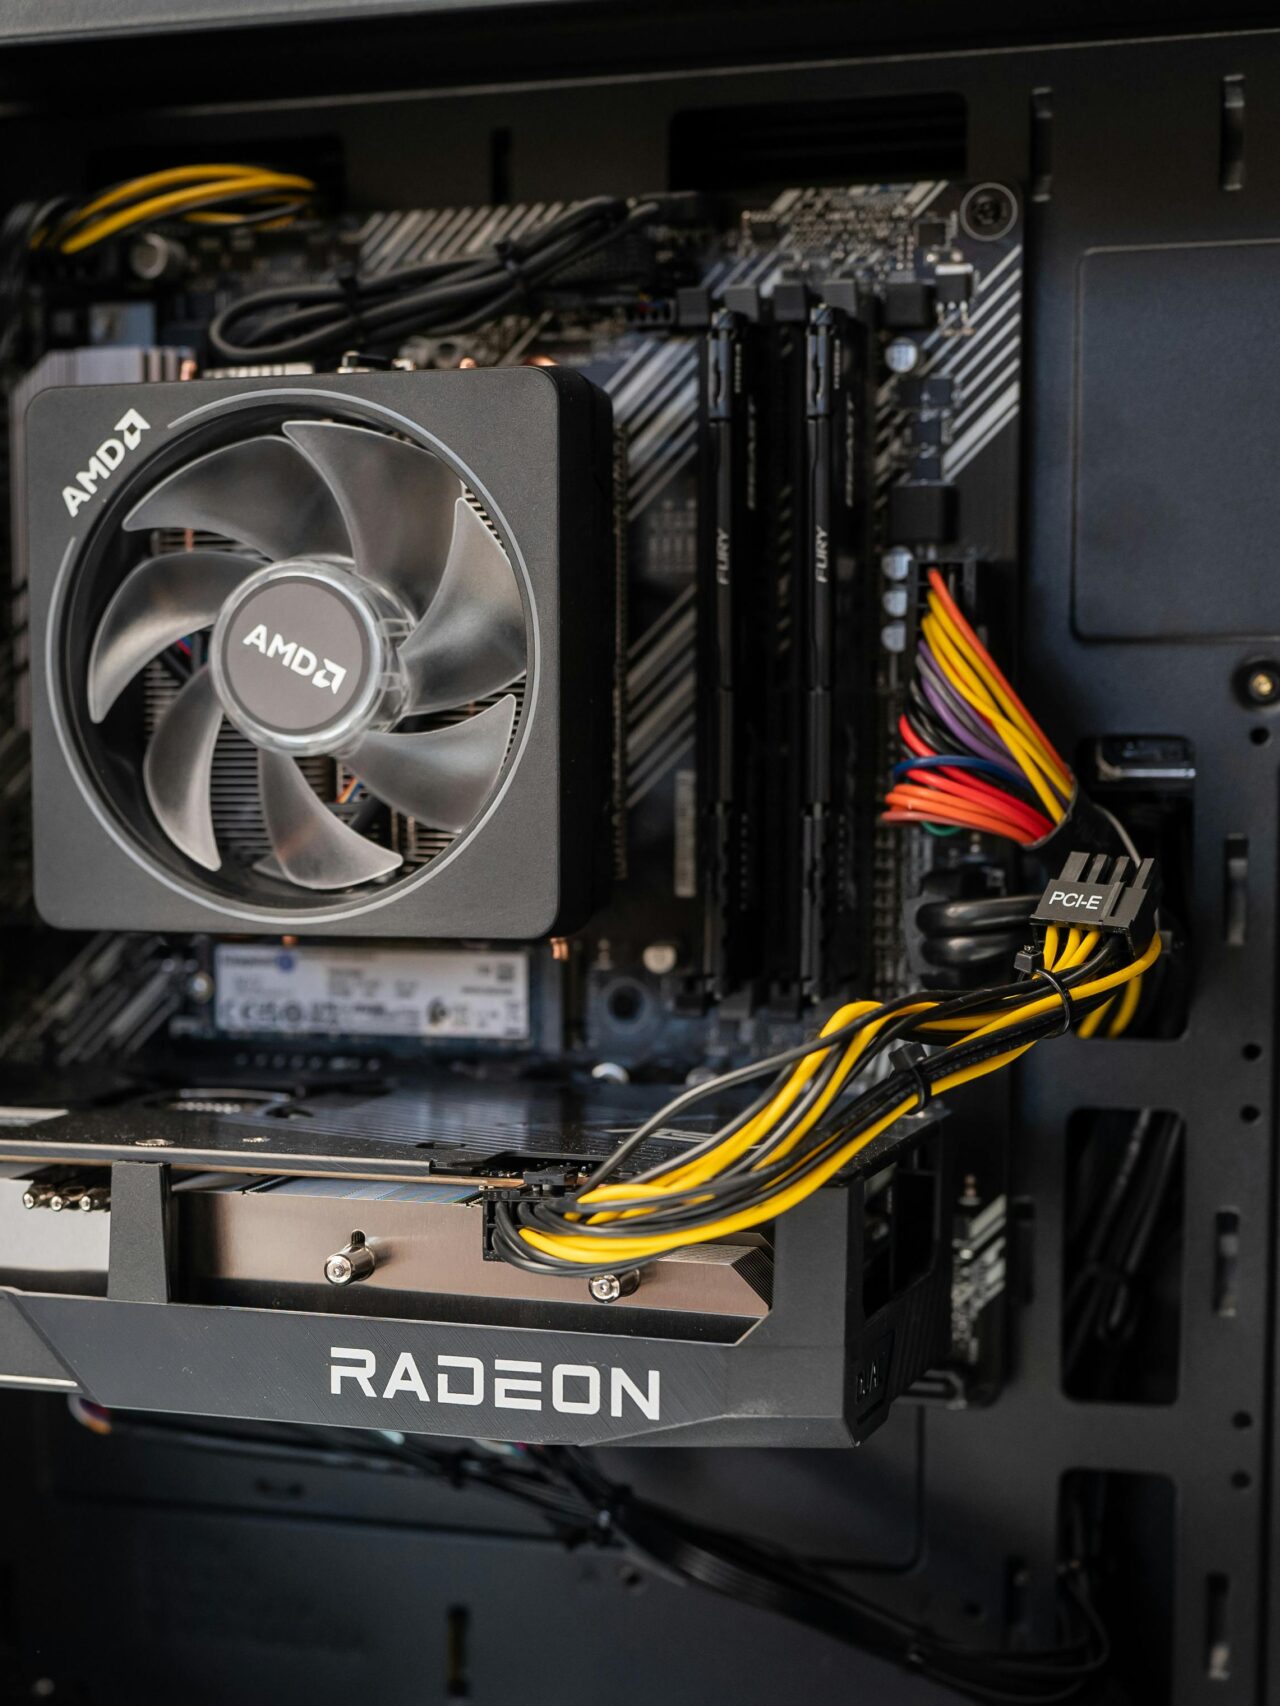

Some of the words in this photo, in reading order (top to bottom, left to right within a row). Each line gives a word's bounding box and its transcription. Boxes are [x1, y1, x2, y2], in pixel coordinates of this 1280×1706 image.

[62, 439, 125, 517] AMD
[717, 527, 729, 584] FURY
[815, 524, 828, 582] FURY
[242, 624, 318, 677] AMD
[1048, 891, 1103, 910] PCI-E
[330, 1346, 660, 1421] RADEON
